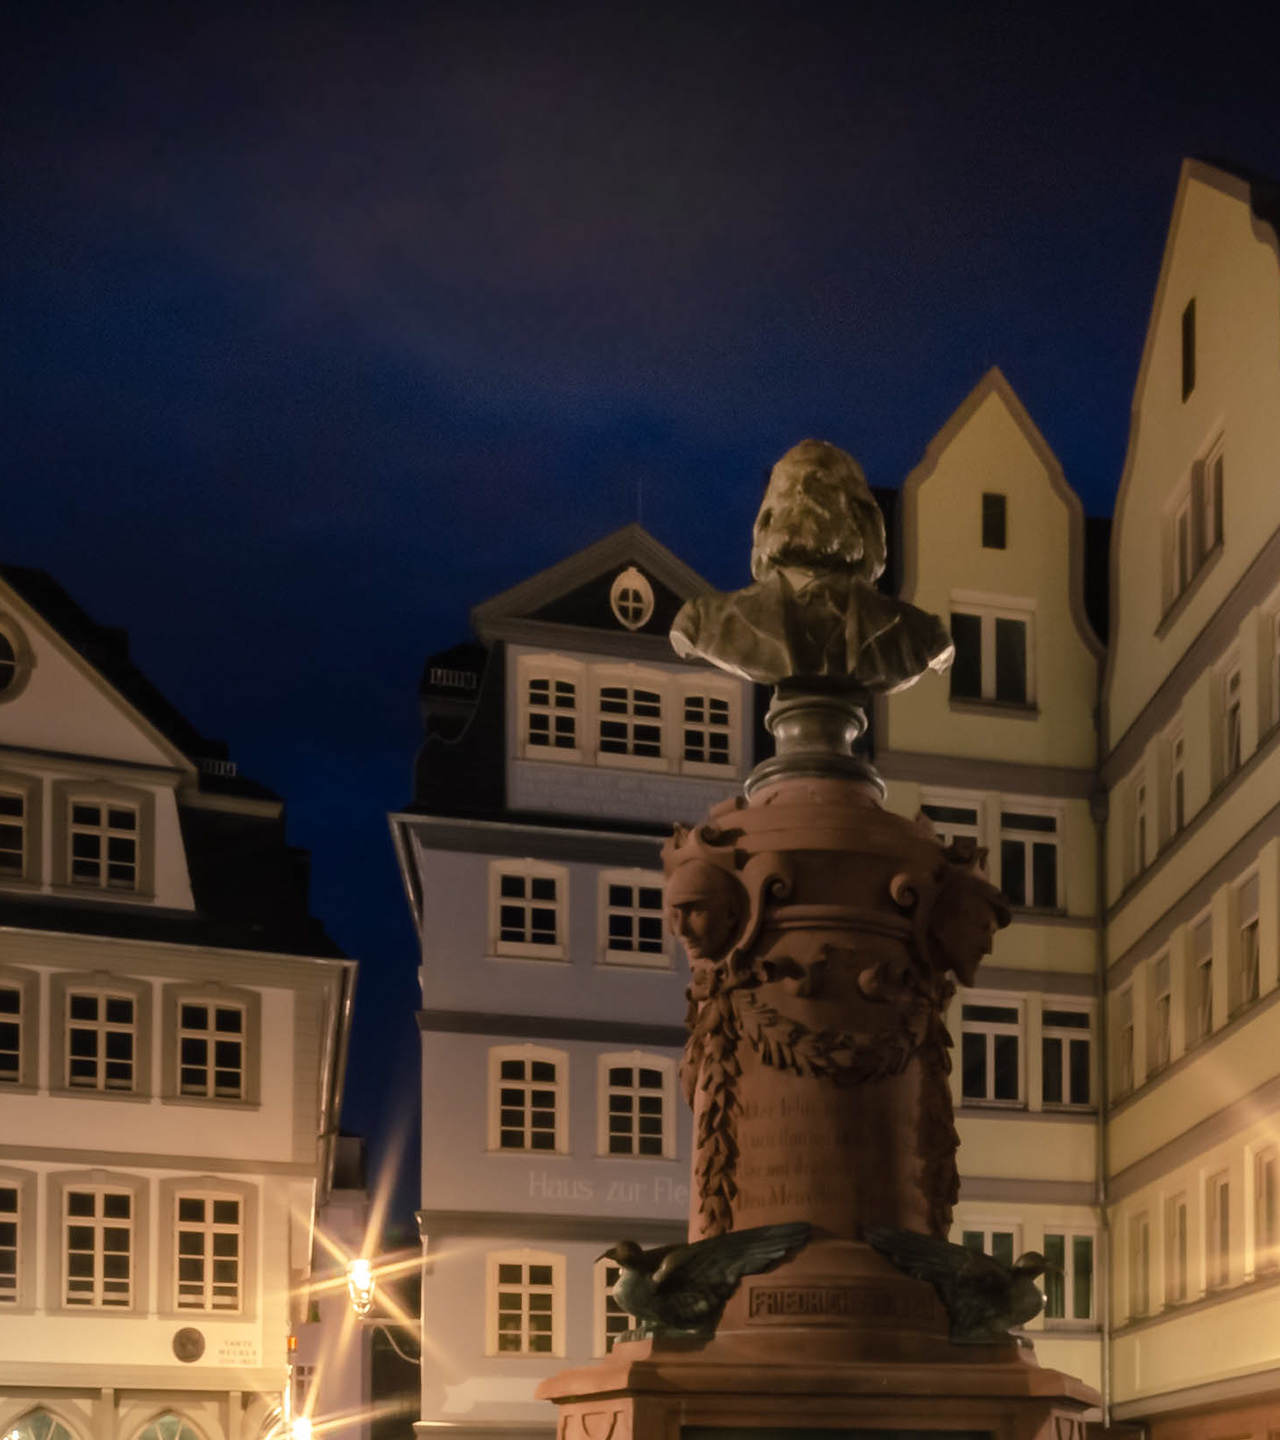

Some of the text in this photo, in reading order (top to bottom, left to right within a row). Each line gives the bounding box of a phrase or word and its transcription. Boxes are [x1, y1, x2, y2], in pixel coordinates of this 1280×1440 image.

[528, 1170, 689, 1204] Haus zur Fle
